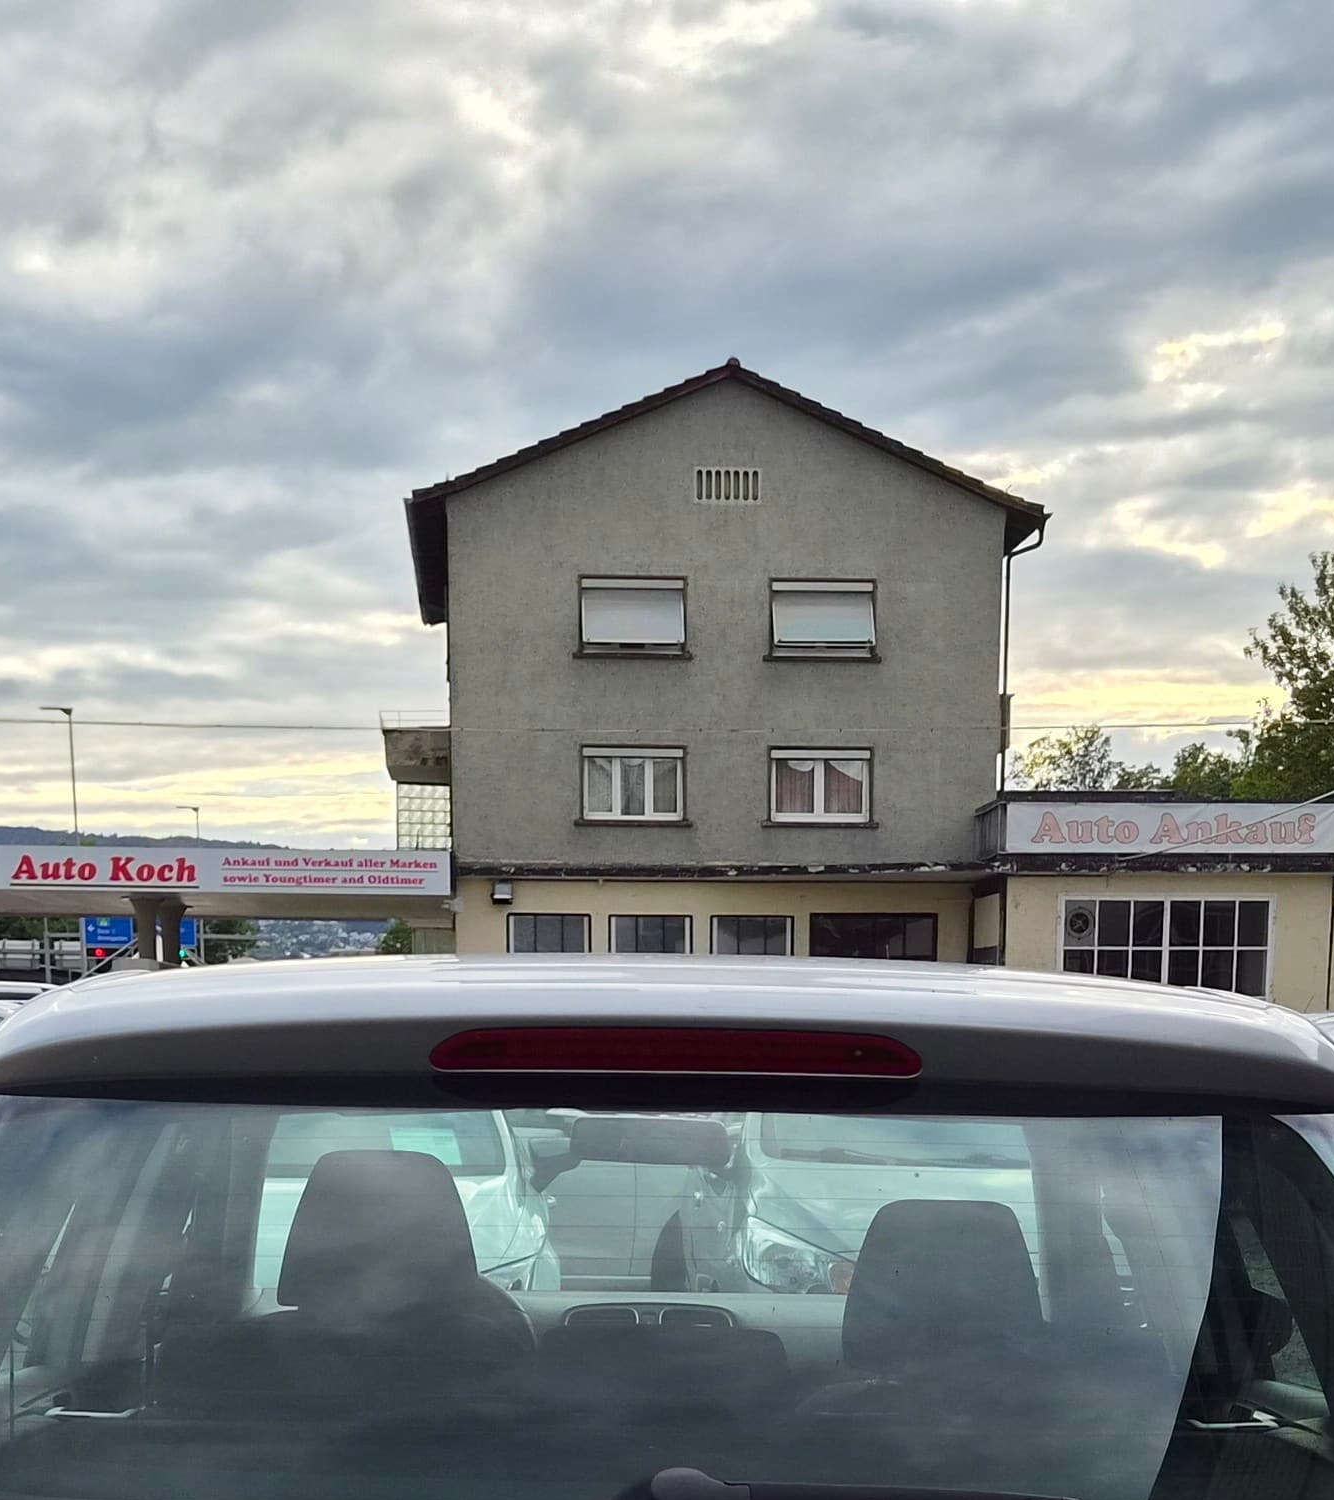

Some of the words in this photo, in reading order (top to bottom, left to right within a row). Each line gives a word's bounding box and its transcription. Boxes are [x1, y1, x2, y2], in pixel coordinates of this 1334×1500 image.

[1031, 811, 1140, 845] Auto
[1149, 812, 1317, 846] Ankauf
[11, 854, 97, 881] Auto
[109, 856, 197, 883] Koch
[222, 857, 271, 868] Ankauf
[274, 858, 299, 868] und
[302, 858, 354, 869] Verkauf
[356, 859, 386, 869] aller
[389, 860, 438, 870] Marken
[222, 874, 260, 884] sowie
[263, 874, 338, 887] Youngtimer
[367, 875, 426, 886] Oldtimer
